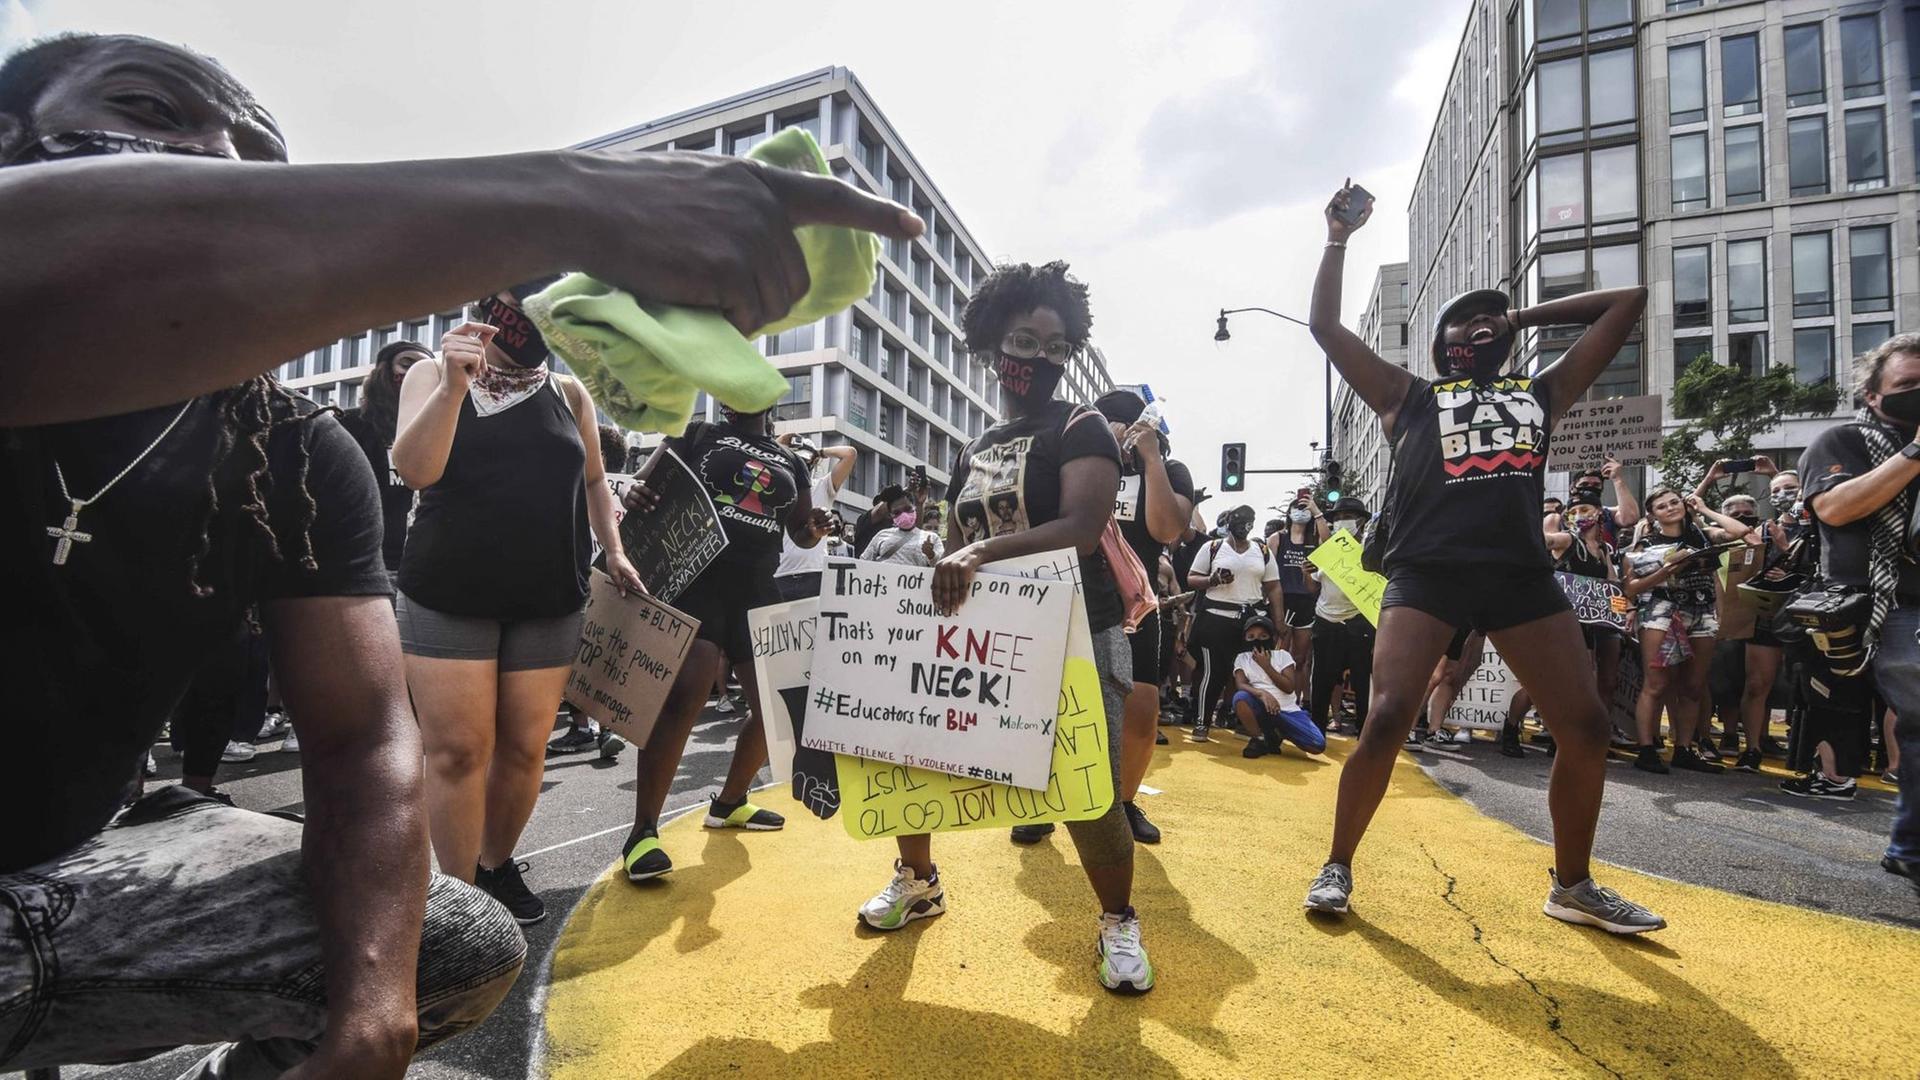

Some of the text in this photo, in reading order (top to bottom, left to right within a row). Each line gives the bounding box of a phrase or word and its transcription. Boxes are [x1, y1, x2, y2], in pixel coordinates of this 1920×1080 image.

[1439, 392, 1545, 436] LAW
[1561, 405, 1623, 419] ONT STOP
[1563, 416, 1644, 430] FIGHTING AND
[1441, 426, 1533, 460] BLSA
[1551, 425, 1661, 442] DONT STOP BELIEVING
[1551, 440, 1658, 456] YOU CAN MAKE THE
[716, 437, 789, 465] Black
[1572, 462, 1584, 470] FOR
[1578, 452, 1614, 460] WORLD
[1113, 501, 1131, 516] PE.
[661, 493, 707, 559] NECK!
[828, 562, 888, 597] That's
[897, 572, 925, 591] not
[989, 580, 1009, 597] on
[1018, 583, 1049, 604] my
[1330, 558, 1382, 610] Matt
[1560, 575, 1584, 594] We
[640, 607, 682, 638] #BLM
[577, 640, 603, 667] TOP
[584, 621, 605, 643] ave
[608, 628, 628, 658] the
[821, 611, 1033, 672] That's your KNEE
[841, 650, 1012, 708] on my NECK!
[1471, 668, 1506, 683] EDS
[576, 678, 592, 697] the
[593, 690, 633, 725] manager.
[1460, 687, 1505, 703] ITE
[813, 687, 914, 726] #Educators
[919, 707, 941, 728] for
[946, 708, 978, 732] BLM
[1041, 718, 1053, 736] X
[1446, 707, 1508, 723] UPREMACY
[805, 738, 846, 753] WHITE
[853, 745, 895, 761] SILENCE
[904, 754, 914, 765] IS
[918, 757, 965, 774] VIOLENCE
[968, 765, 1013, 783] #BLM
[862, 765, 927, 802] JUST
[860, 763, 1102, 836] I DID NOT GO TO
